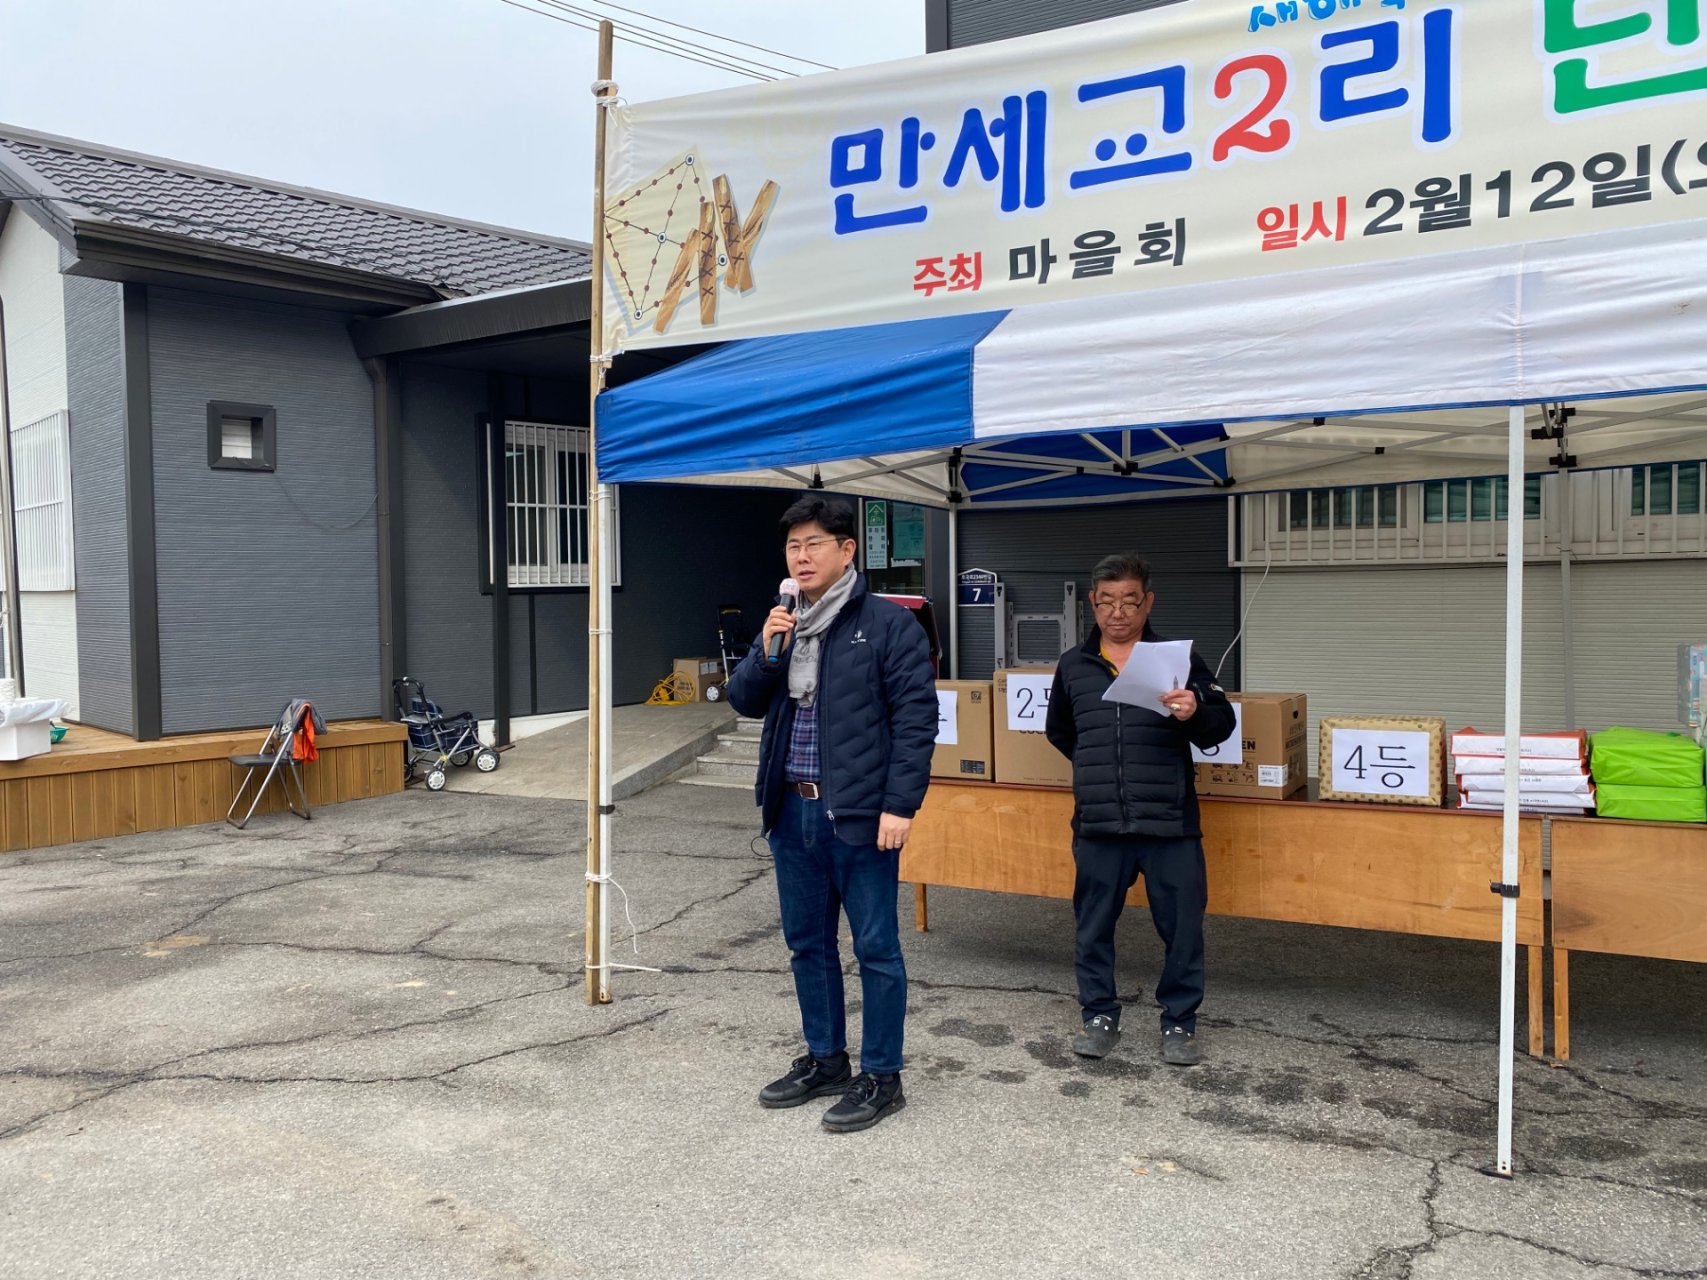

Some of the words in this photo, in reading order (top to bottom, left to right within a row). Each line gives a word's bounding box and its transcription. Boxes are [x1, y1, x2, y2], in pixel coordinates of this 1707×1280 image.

[830, 9, 1452, 235] 만세교2리
[914, 252, 982, 296] 주최
[1257, 196, 1347, 251] 일시
[972, 587, 982, 602] 7
[1343, 744, 1416, 789] 4등
